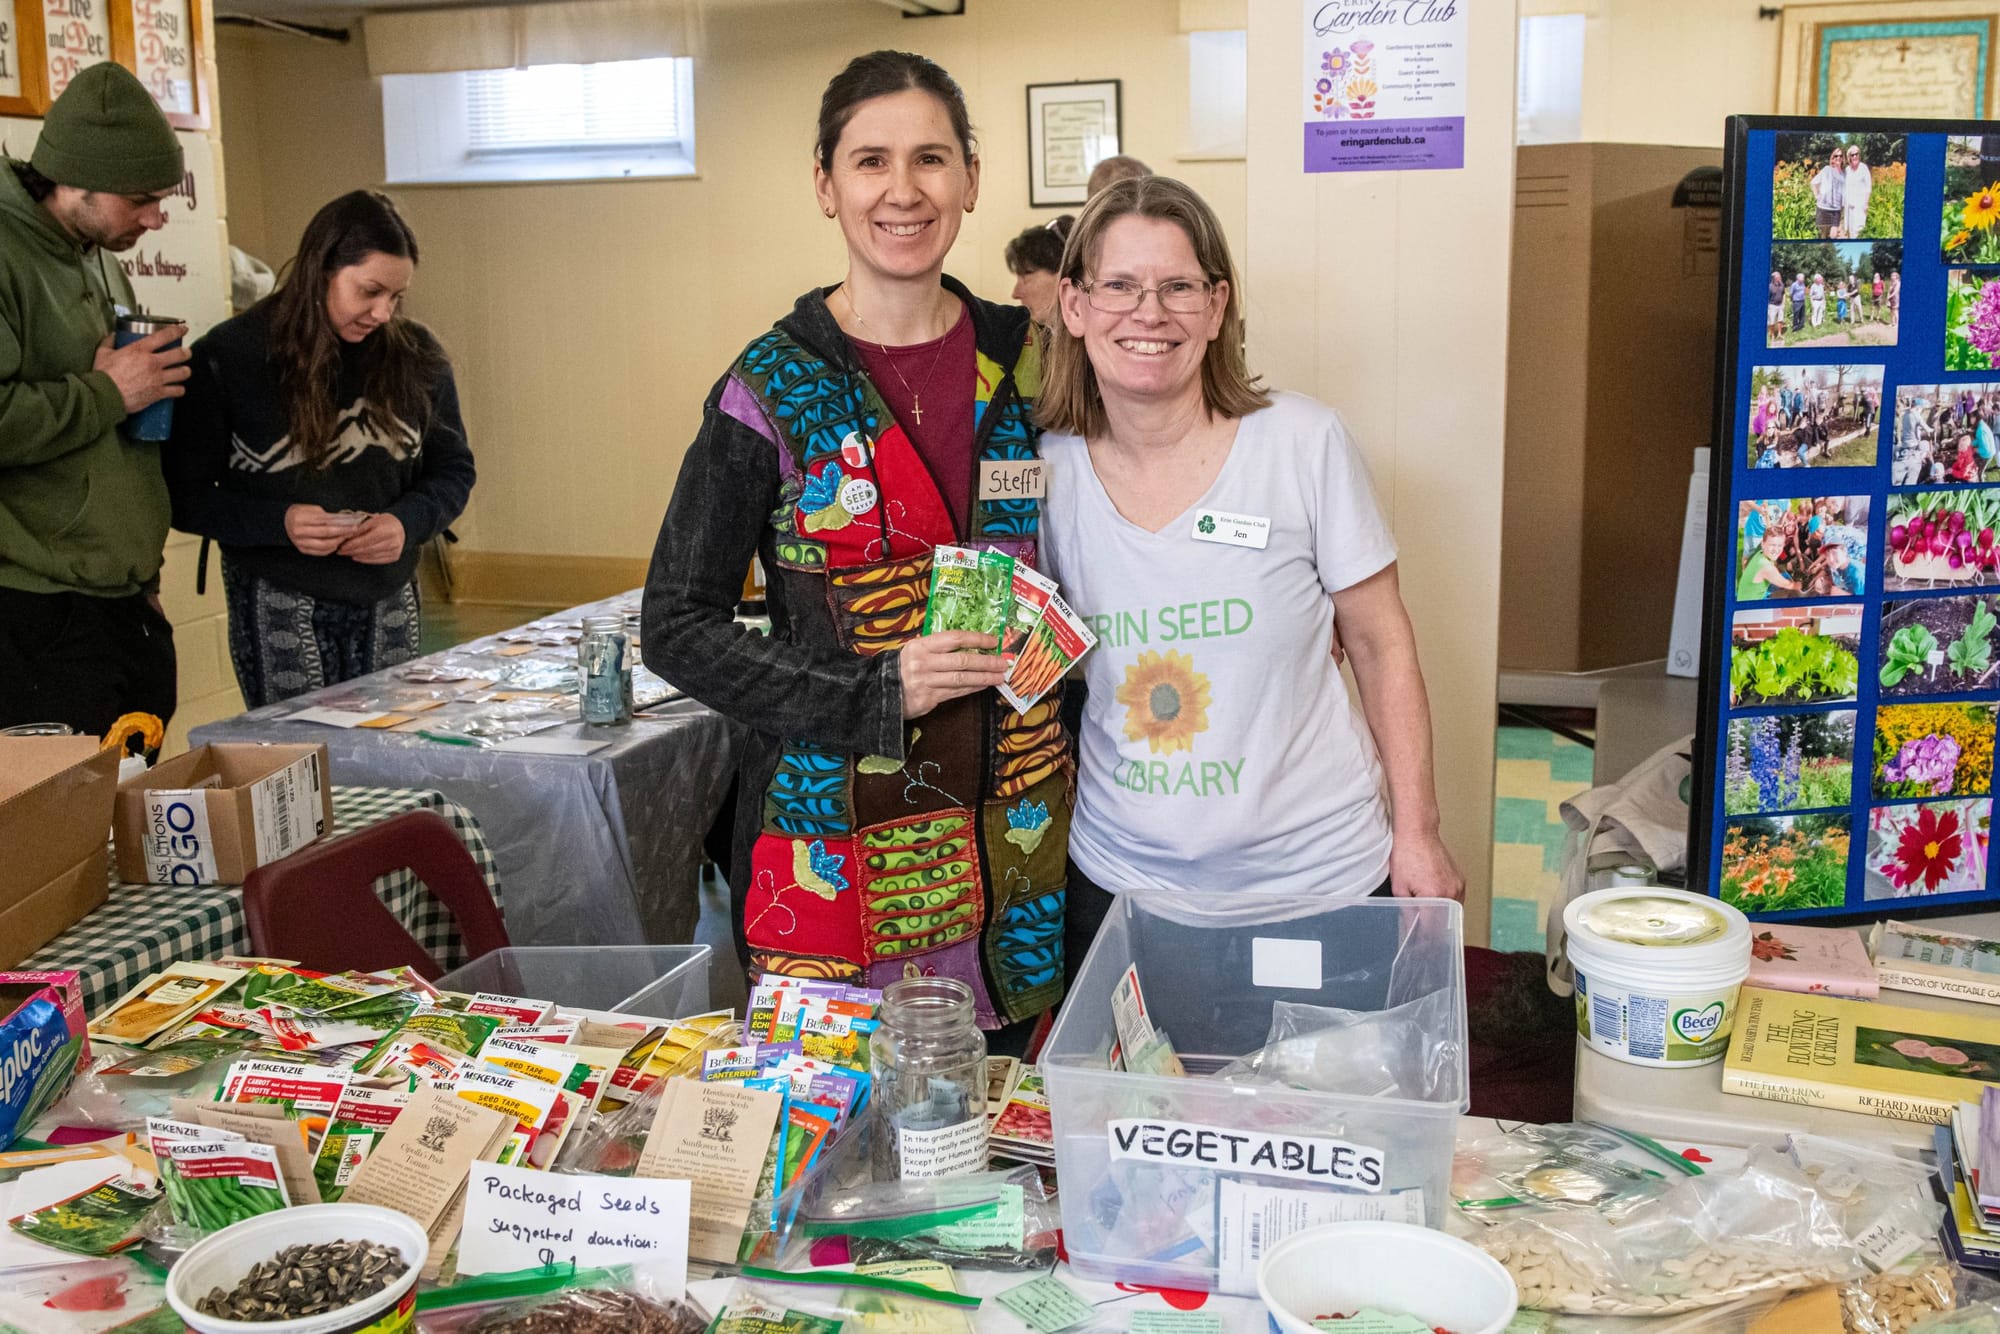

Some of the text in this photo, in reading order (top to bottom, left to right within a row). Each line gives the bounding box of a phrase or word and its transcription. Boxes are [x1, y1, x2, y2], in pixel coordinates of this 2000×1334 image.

[1313, 0, 1457, 37] Garden Club
[139, 32, 186, 66] Does
[1324, 129, 1339, 138] join
[1349, 127, 1359, 135] for
[1380, 126, 1393, 134] info
[1340, 136, 1426, 148] eringardenclub.ca
[136, 249, 156, 276] the
[156, 249, 187, 281] things
[989, 465, 1042, 494] Steffi
[845, 490, 874, 506] SEED
[1233, 530, 1248, 539] Jen
[1158, 597, 1255, 642] SEED
[1113, 756, 1247, 797] LIBRARY
[1902, 975, 1986, 997] BOOK OF VEGETABLE
[805, 1018, 848, 1034] BURPEE
[1682, 1013, 1718, 1030] Becel
[1765, 1023, 1791, 1045] THE
[1787, 1009, 1817, 1067] FLOWERING
[1812, 1014, 1840, 1067] OF BRITAIN
[709, 1056, 752, 1068] BURPEE
[247, 1078, 271, 1087] CARROT
[706, 1070, 759, 1081] CANTERBUR
[243, 1086, 272, 1095] CAROTTE
[1761, 1082, 1825, 1100] FLOWERING
[1766, 1091, 1809, 1105] BRITAIN
[1858, 1095, 1951, 1119] RICHARD MABEY
[1875, 1108, 1944, 1125] TONY EVANS
[682, 1138, 718, 1151] Sunflower
[903, 1132, 986, 1156] Nothing really matters
[904, 1123, 980, 1145] In the grand scheme
[904, 1147, 973, 1168] Except for Human
[1114, 1123, 1382, 1187] VEGETABLES
[904, 1169, 921, 1177] And
[922, 1170, 932, 1178] an
[933, 1157, 978, 1178] appreciation
[100, 1187, 119, 1198] DILL
[484, 1176, 582, 1215] Packaged
[600, 1192, 661, 1215] Seeds
[587, 1230, 659, 1249] donation:
